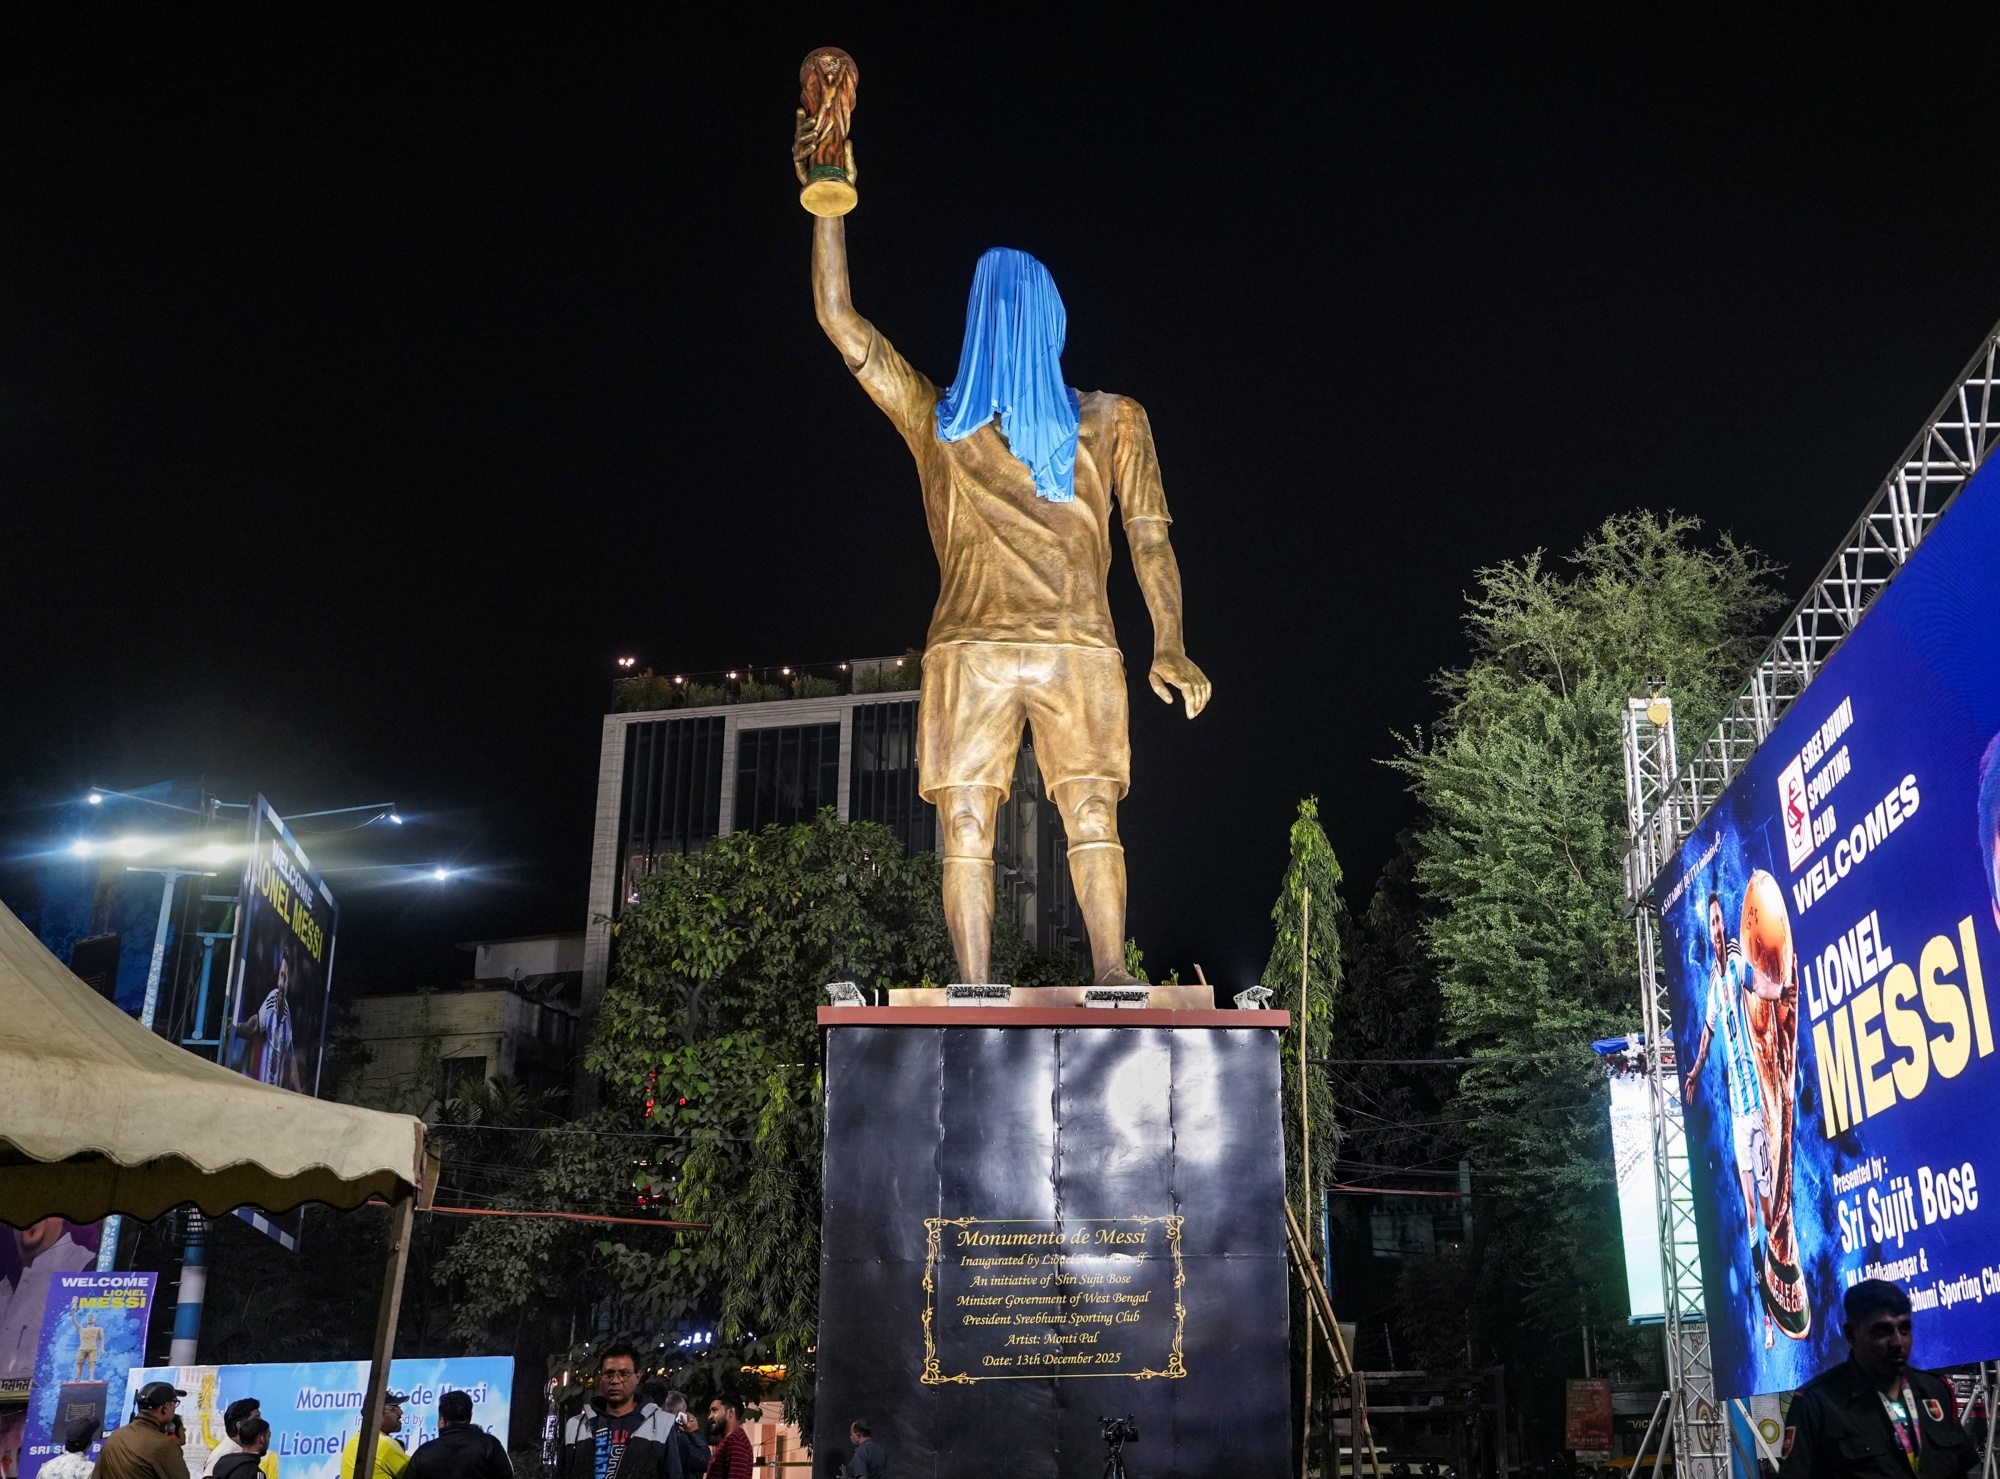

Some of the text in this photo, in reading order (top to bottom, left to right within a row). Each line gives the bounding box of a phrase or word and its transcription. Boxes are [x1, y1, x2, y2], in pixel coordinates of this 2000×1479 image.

[1801, 695, 1853, 773] SREE BHUMI
[1807, 745, 1851, 810] SPORTING
[1813, 805, 1836, 848] CLUB
[1792, 774, 1920, 915] WELCOMES
[272, 839, 314, 910] WELCOME
[255, 853, 324, 963] IONEL MESSI
[1804, 909, 1893, 1022] LIONEL
[1812, 914, 1995, 1140] MESSI
[1833, 1158, 1870, 1195] Presented
[1871, 1156, 1883, 1182] by
[1838, 1162, 1979, 1254] Sri Sujit Bose
[957, 1228, 1147, 1246] Monumento de Messi
[960, 1254, 1024, 1269] Inaugurated
[1027, 1253, 1040, 1268] by
[1041, 1253, 1076, 1265] Lionel
[1919, 1247, 1929, 1273] &
[61, 1277, 149, 1288] WELCOME
[970, 1273, 1131, 1287] An initiative of Shri Sujit Bose
[1773, 1277, 1801, 1296] FIFA
[103, 1289, 147, 1297] LIONEL
[957, 1291, 1151, 1308] Minister Government of West Bengal
[1938, 1274, 1982, 1309] Sporting
[78, 1297, 147, 1309] MESSI
[962, 1310, 1140, 1327] President Sreebhumi Sporting Club
[1004, 1331, 1099, 1346] Artist: Monti Pal
[982, 1353, 1121, 1367] Date: 13th December 2025
[411, 1385, 433, 1405] de
[413, 1414, 424, 1426] by
[29, 1445, 51, 1455] SRI
[280, 1430, 345, 1456] Lionel
